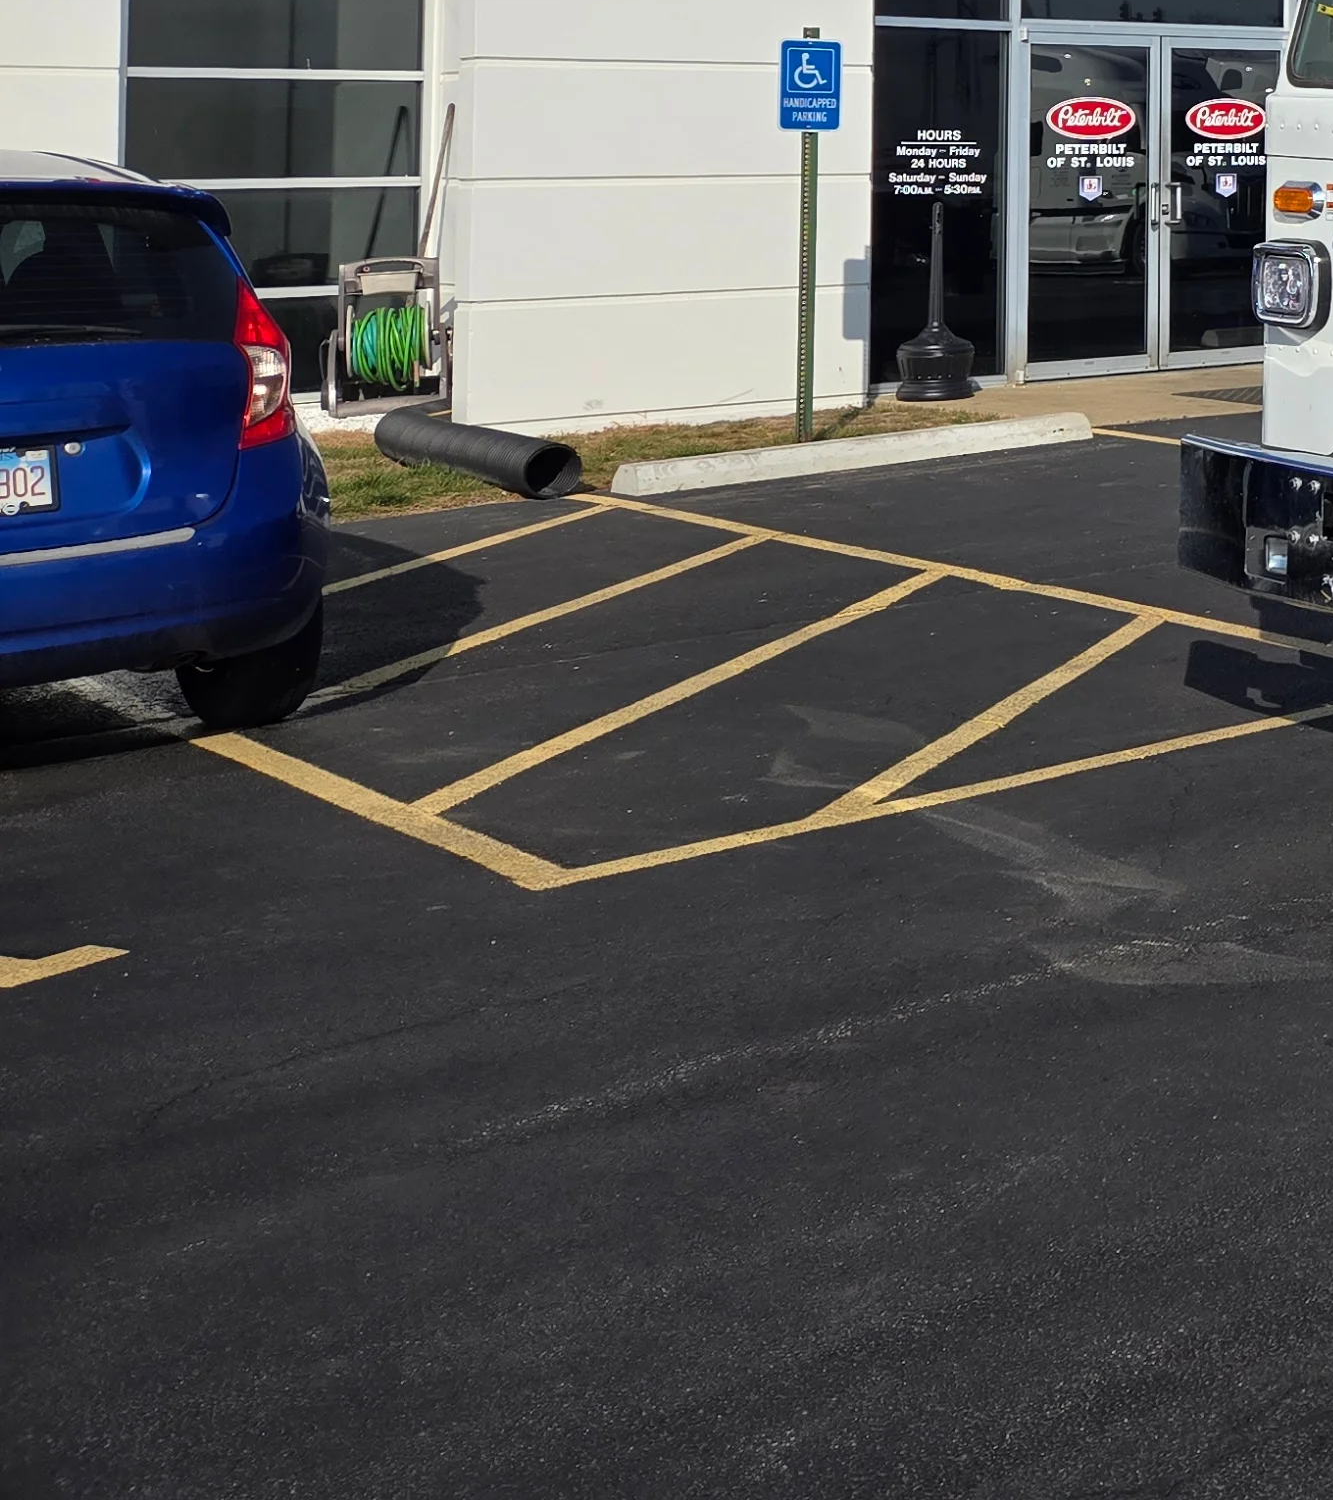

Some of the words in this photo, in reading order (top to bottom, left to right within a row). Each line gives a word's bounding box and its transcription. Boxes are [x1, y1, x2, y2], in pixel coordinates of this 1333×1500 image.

[783, 97, 837, 109] HANDICAPPED
[792, 111, 828, 122] PARKING
[1058, 105, 1127, 128] Peterbilt
[1196, 106, 1260, 128] Peterbilt
[917, 129, 962, 141] HOURS
[896, 145, 938, 157] Monday
[949, 145, 981, 157] Friday
[1055, 143, 1127, 155] PETERBILT
[1193, 142, 1260, 154] PETERBILT
[910, 158, 925, 169] 24
[928, 158, 967, 169] HOURS
[1046, 156, 1066, 168] OF
[1095, 156, 1135, 168] LOUIS
[1185, 155, 1204, 167] OF
[1230, 155, 1267, 166] LOUIS
[888, 172, 937, 184] Saturday
[948, 172, 988, 184] Sunday
